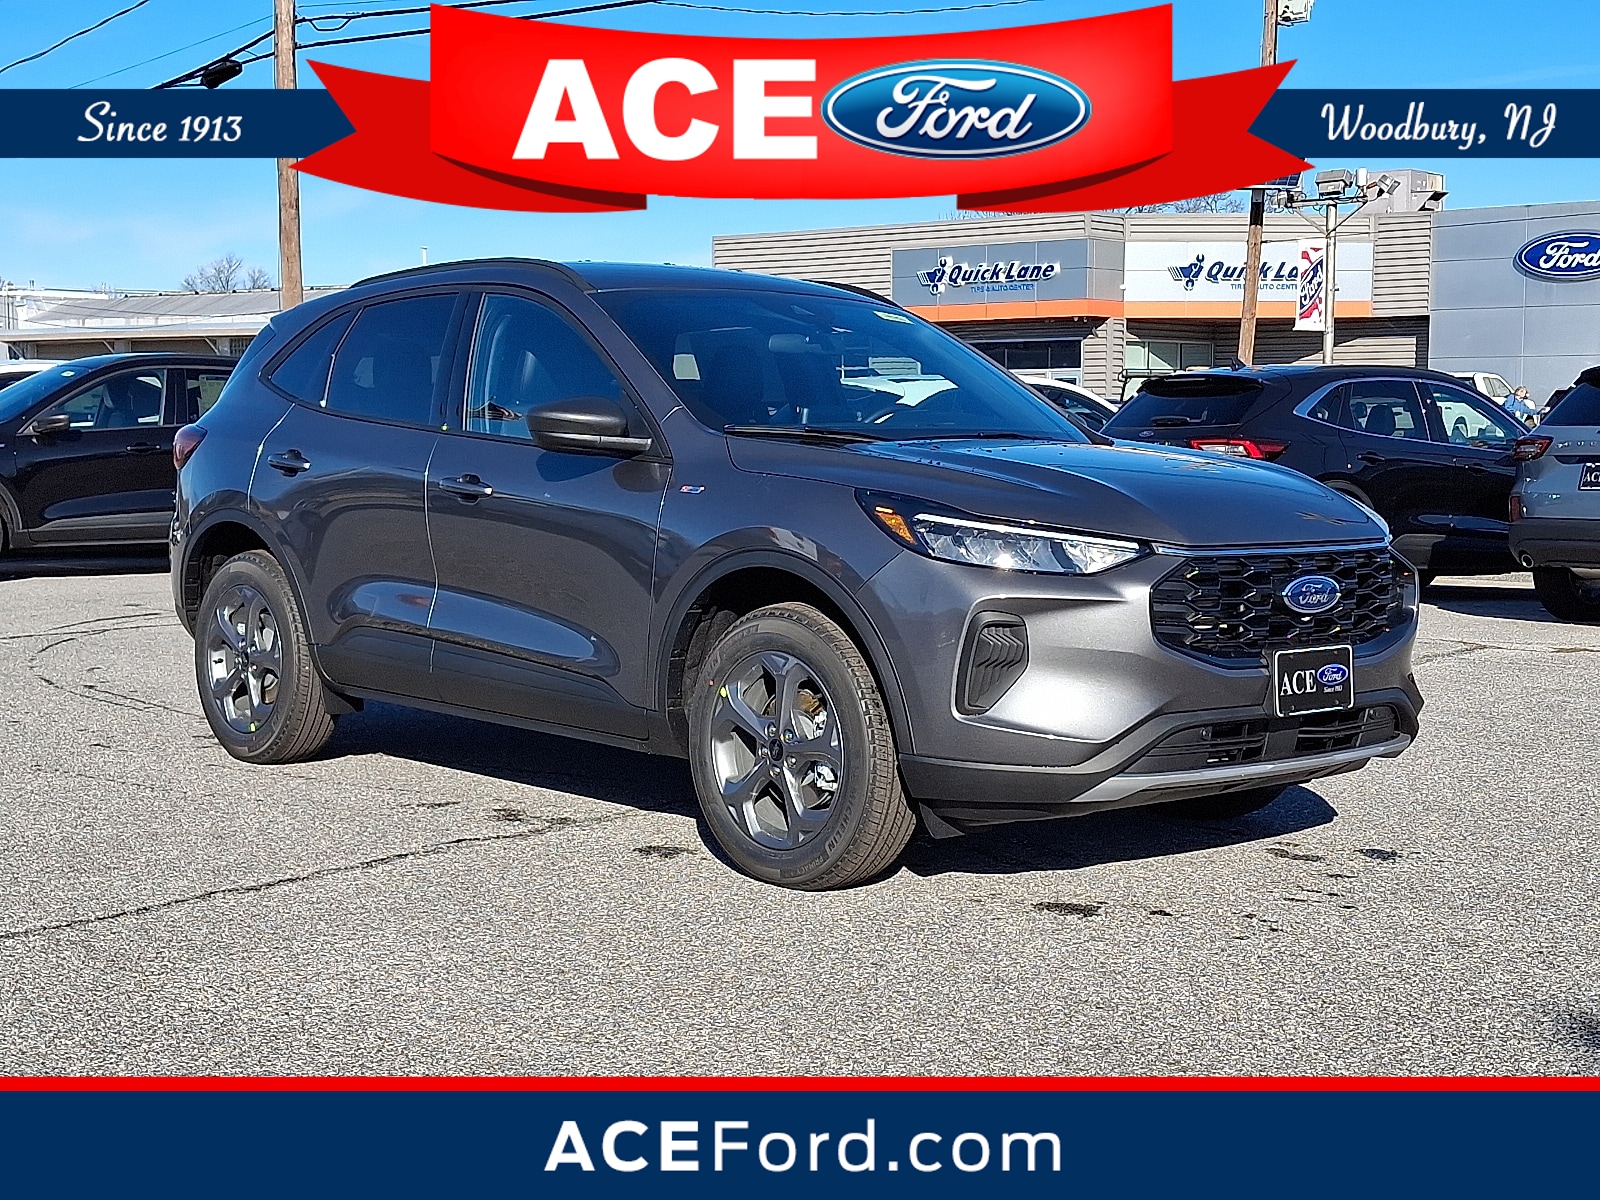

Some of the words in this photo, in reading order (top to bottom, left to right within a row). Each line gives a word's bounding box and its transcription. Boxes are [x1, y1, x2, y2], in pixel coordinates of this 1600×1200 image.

[1539, 241, 1600, 269] Ford
[949, 263, 1003, 284] Quick
[1005, 262, 1056, 281] Lane
[1206, 261, 1274, 283] Quik
[1299, 583, 1332, 605] Ford
[1280, 669, 1316, 696] ACE
[1322, 667, 1343, 681] Ford
